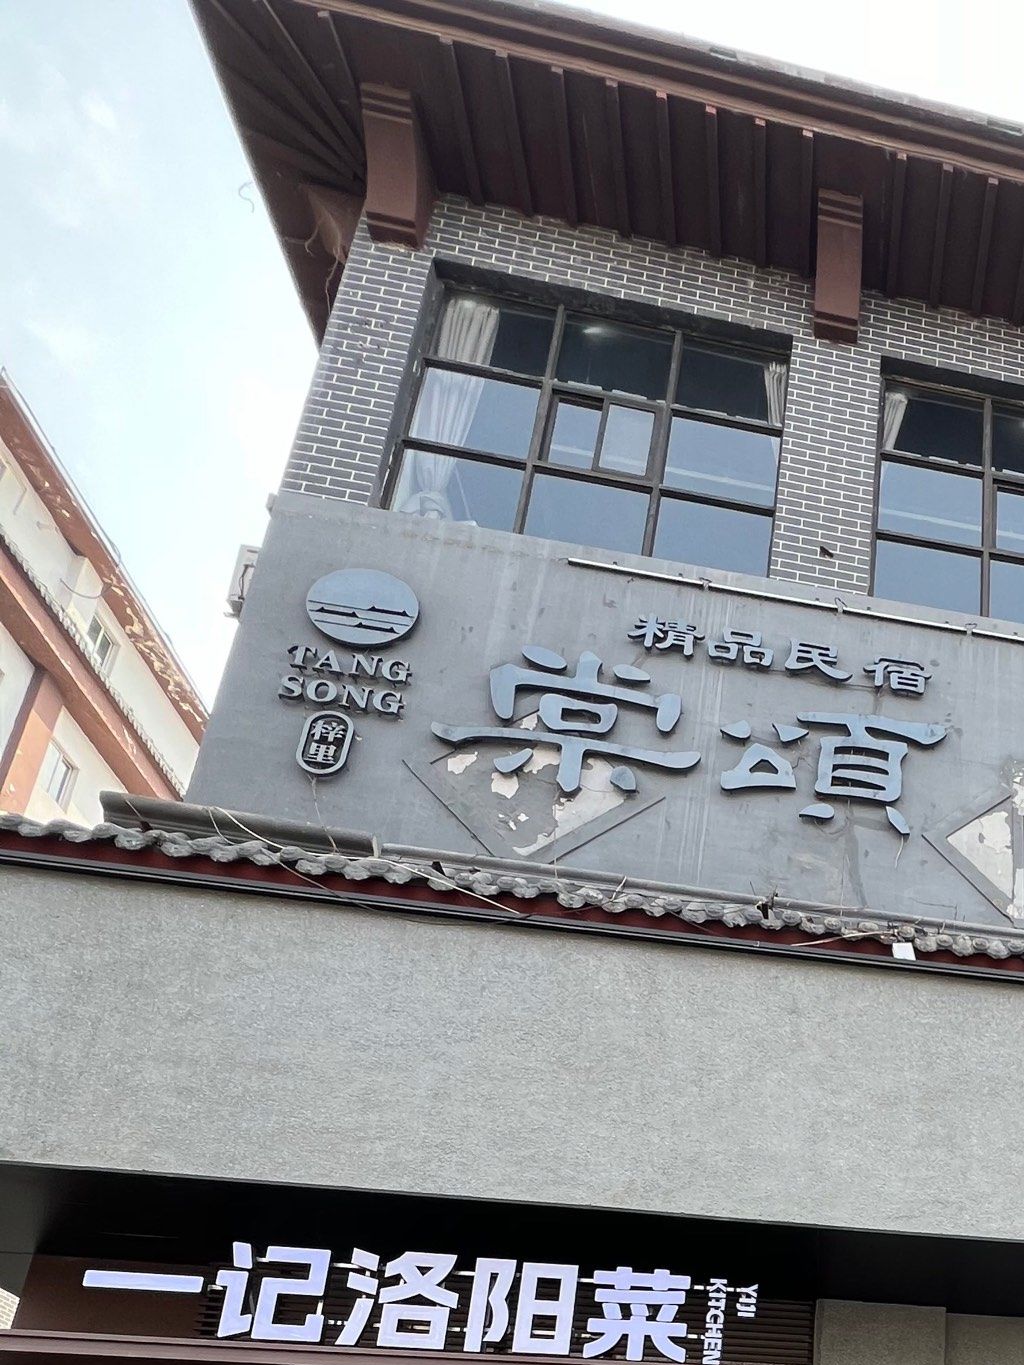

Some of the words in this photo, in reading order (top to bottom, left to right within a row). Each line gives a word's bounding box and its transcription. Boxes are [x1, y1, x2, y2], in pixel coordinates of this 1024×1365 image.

[278, 675, 405, 715] SONG
[287, 645, 412, 682] TANG
[629, 614, 933, 696] 精品民宿
[82, 1241, 692, 1364] 一记洛阳菜
[702, 1278, 728, 1365] KITCHEN
